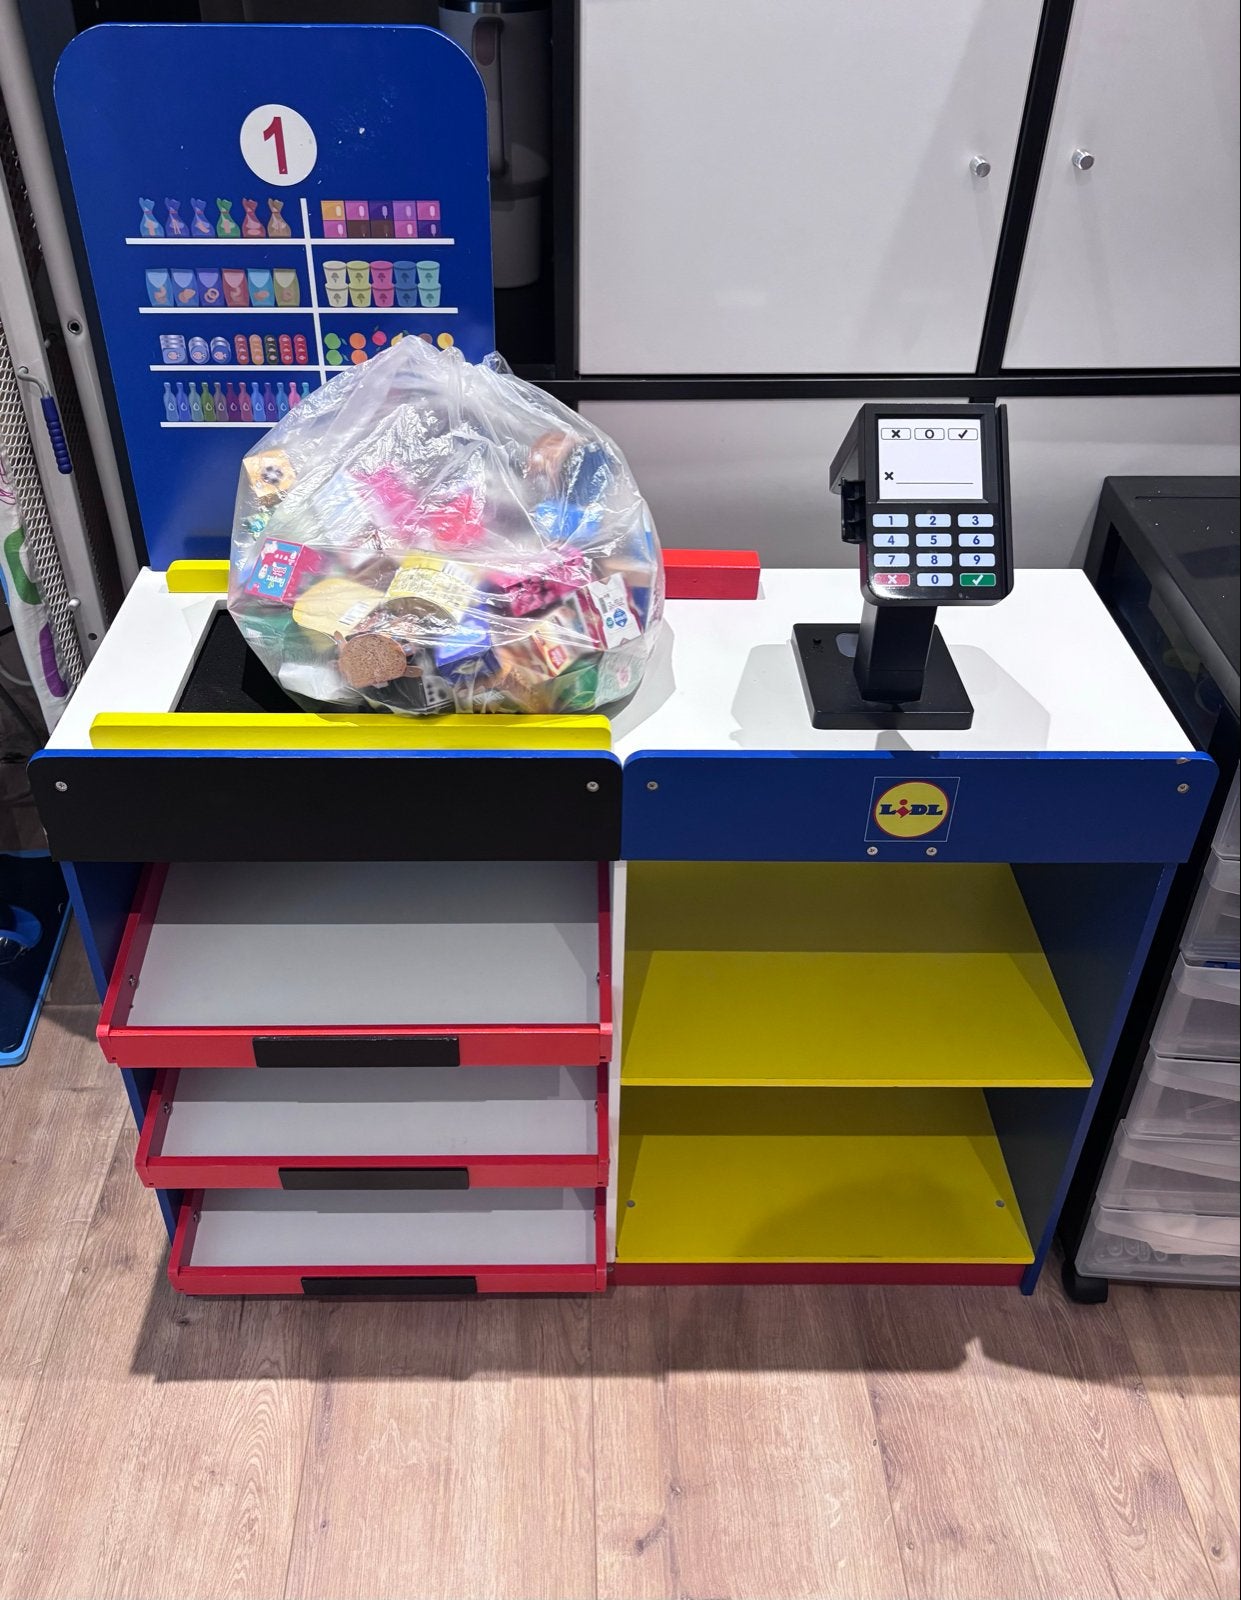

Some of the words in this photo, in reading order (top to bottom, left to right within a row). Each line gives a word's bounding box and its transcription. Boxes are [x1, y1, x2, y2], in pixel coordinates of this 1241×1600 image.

[263, 116, 288, 174] 1
[888, 516, 894, 526] 1
[929, 516, 937, 526] 2
[972, 516, 979, 526] 3
[887, 536, 895, 545] 4
[930, 535, 938, 545] 5
[972, 535, 981, 545] 6
[888, 555, 895, 565] 7
[930, 555, 939, 564] 8
[973, 555, 981, 564] 9
[931, 575, 940, 584] 0
